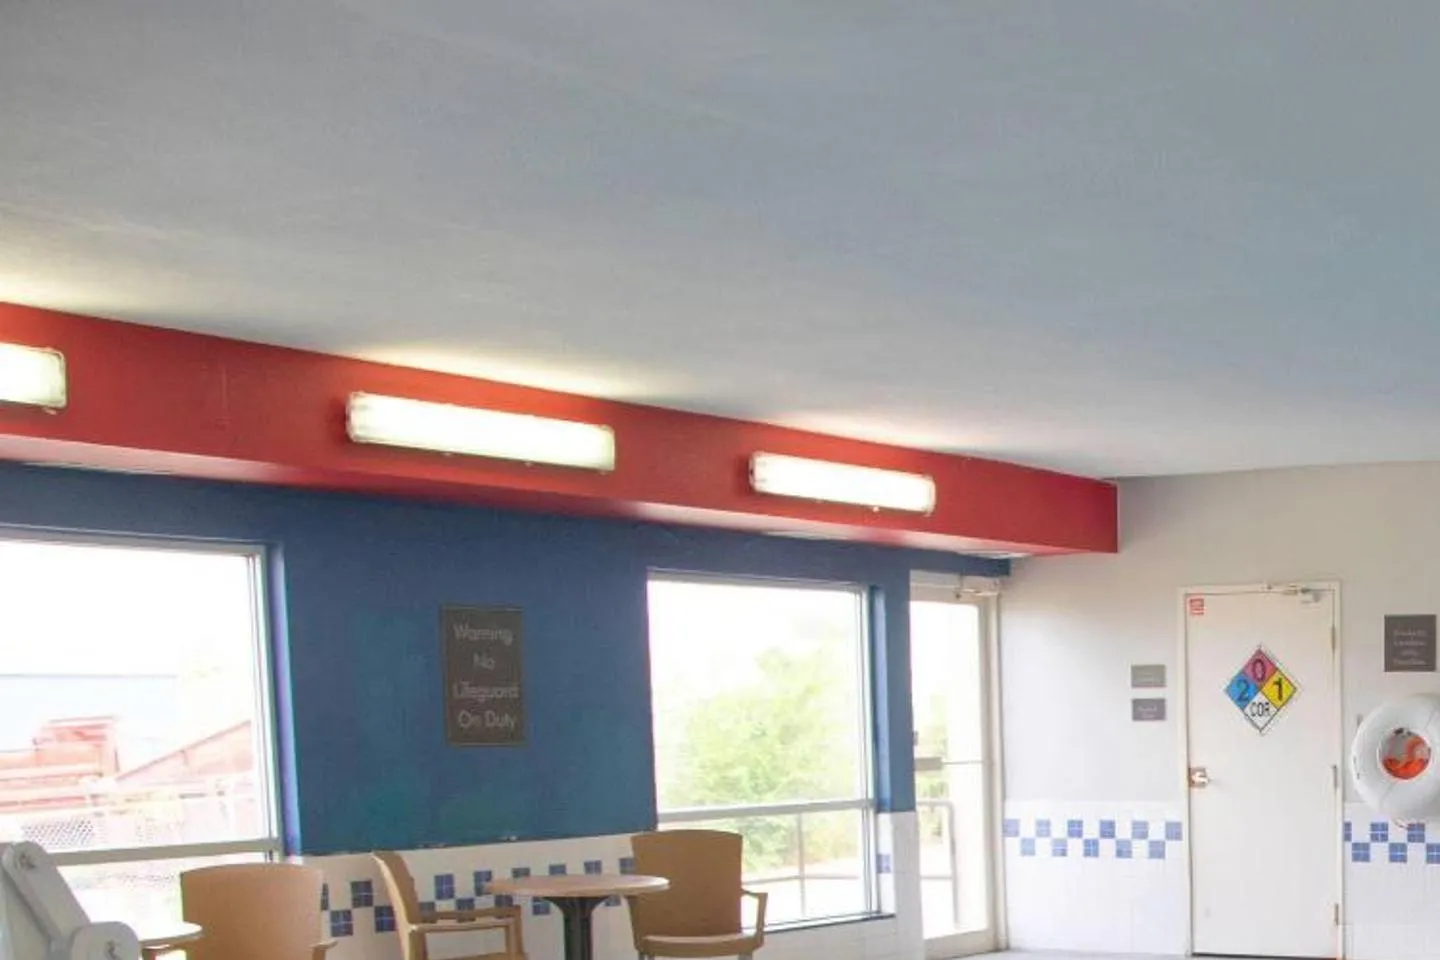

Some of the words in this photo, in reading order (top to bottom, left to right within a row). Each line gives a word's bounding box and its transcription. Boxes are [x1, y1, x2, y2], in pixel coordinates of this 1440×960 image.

[453, 622, 514, 646] Warning
[473, 651, 496, 671] No
[1252, 658, 1266, 682] 0
[1236, 679, 1250, 702] 2
[1272, 677, 1284, 701] 1
[458, 710, 481, 729] On
[485, 709, 518, 733] Duty
